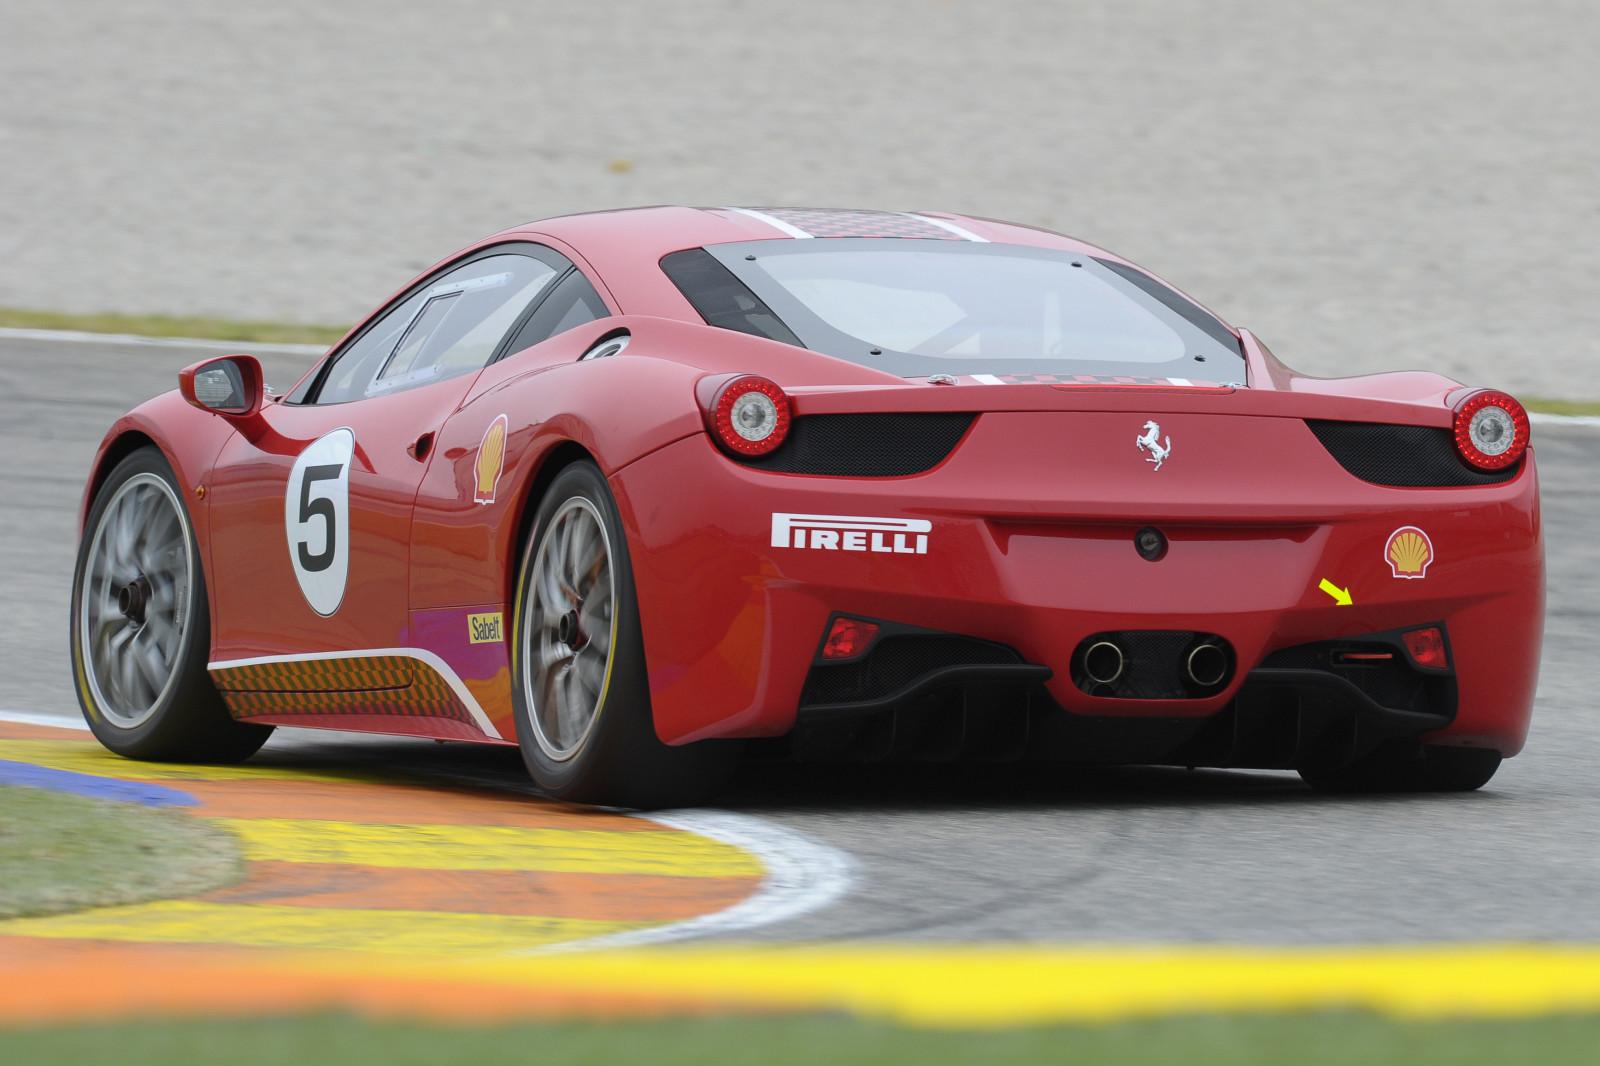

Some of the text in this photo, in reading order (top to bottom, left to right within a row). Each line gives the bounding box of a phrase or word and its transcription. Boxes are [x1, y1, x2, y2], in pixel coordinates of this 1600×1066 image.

[298, 464, 344, 572] 5
[771, 513, 932, 554] PIRELLI
[472, 616, 500, 640] Sabelt
